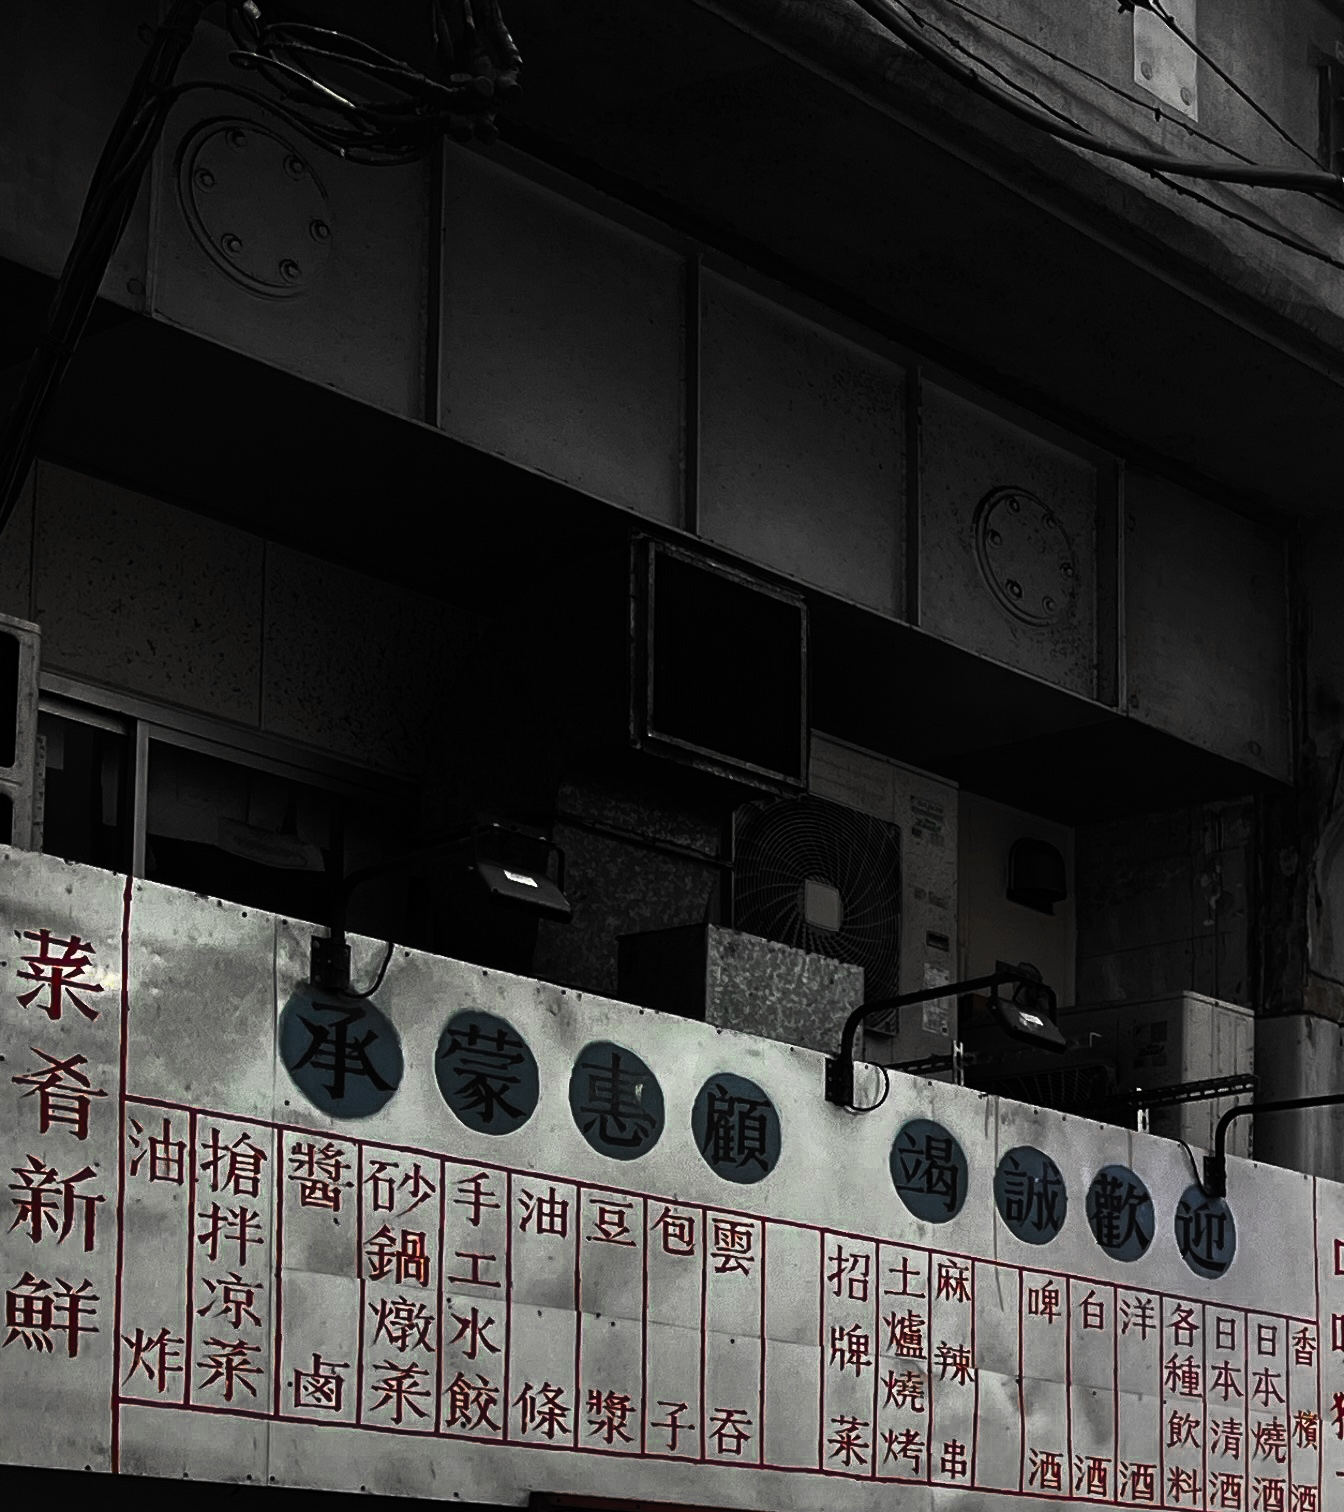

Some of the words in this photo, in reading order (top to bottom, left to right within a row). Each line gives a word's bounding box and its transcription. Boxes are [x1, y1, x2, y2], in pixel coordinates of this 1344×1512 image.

[2, 927, 107, 1361] 菜肴新鮮
[119, 1115, 188, 1394] 油炸
[444, 1170, 502, 1434] 手工水餃
[512, 1184, 574, 1441] 油條
[648, 1203, 698, 1453] 包子
[707, 1215, 756, 1459] 雲吞
[826, 1244, 873, 1470] 招牌菜
[931, 1257, 976, 1481] 麻辣串
[1026, 1279, 1065, 1492] 啤酒
[1073, 1290, 1112, 1500] 白酒
[1117, 1298, 1158, 1503] 洋酒
[1162, 1301, 1203, 1505] 各種飲料
[1206, 1314, 1245, 1512] 日本清酒
